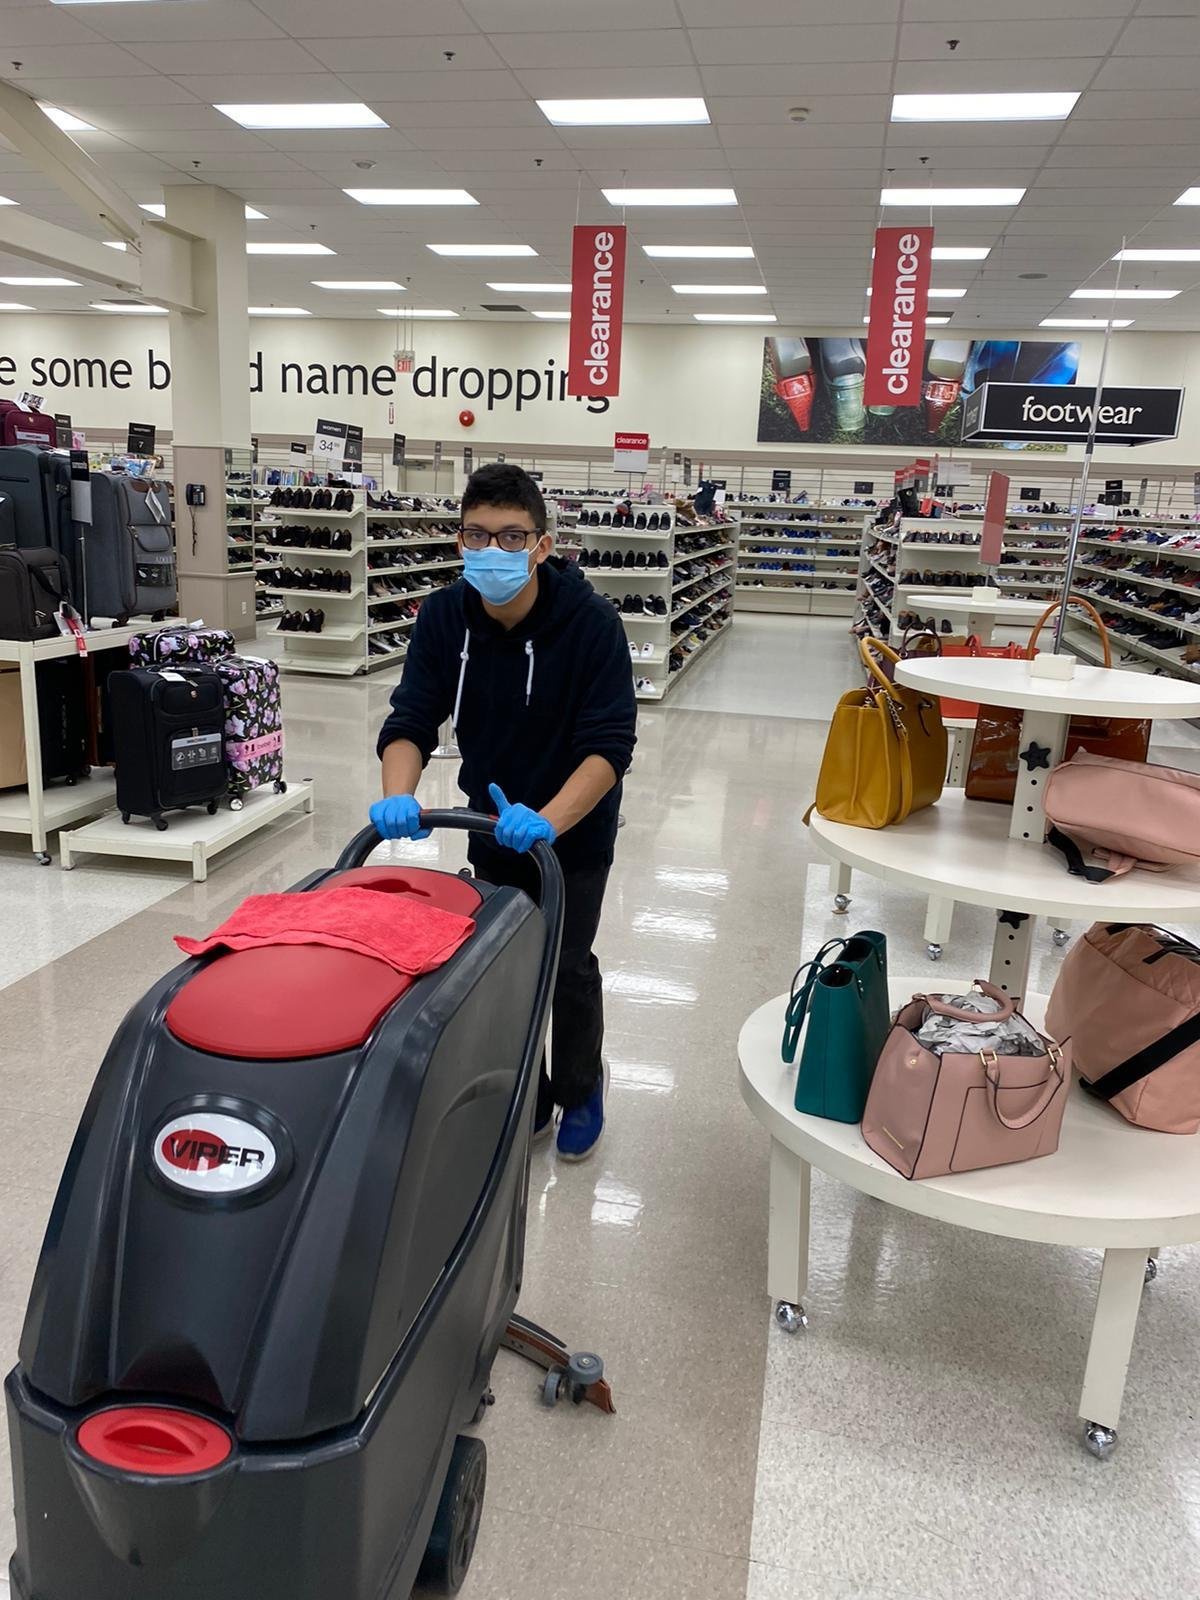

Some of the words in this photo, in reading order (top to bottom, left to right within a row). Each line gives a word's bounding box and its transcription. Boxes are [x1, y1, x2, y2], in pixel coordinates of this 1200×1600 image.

[583, 231, 615, 386] clearance
[881, 233, 921, 395] clearance
[30, 357, 133, 389] some
[281, 363, 397, 396] name
[1021, 396, 1143, 425] footwear
[616, 435, 647, 445] clearance
[170, 1137, 265, 1170] VIPER
